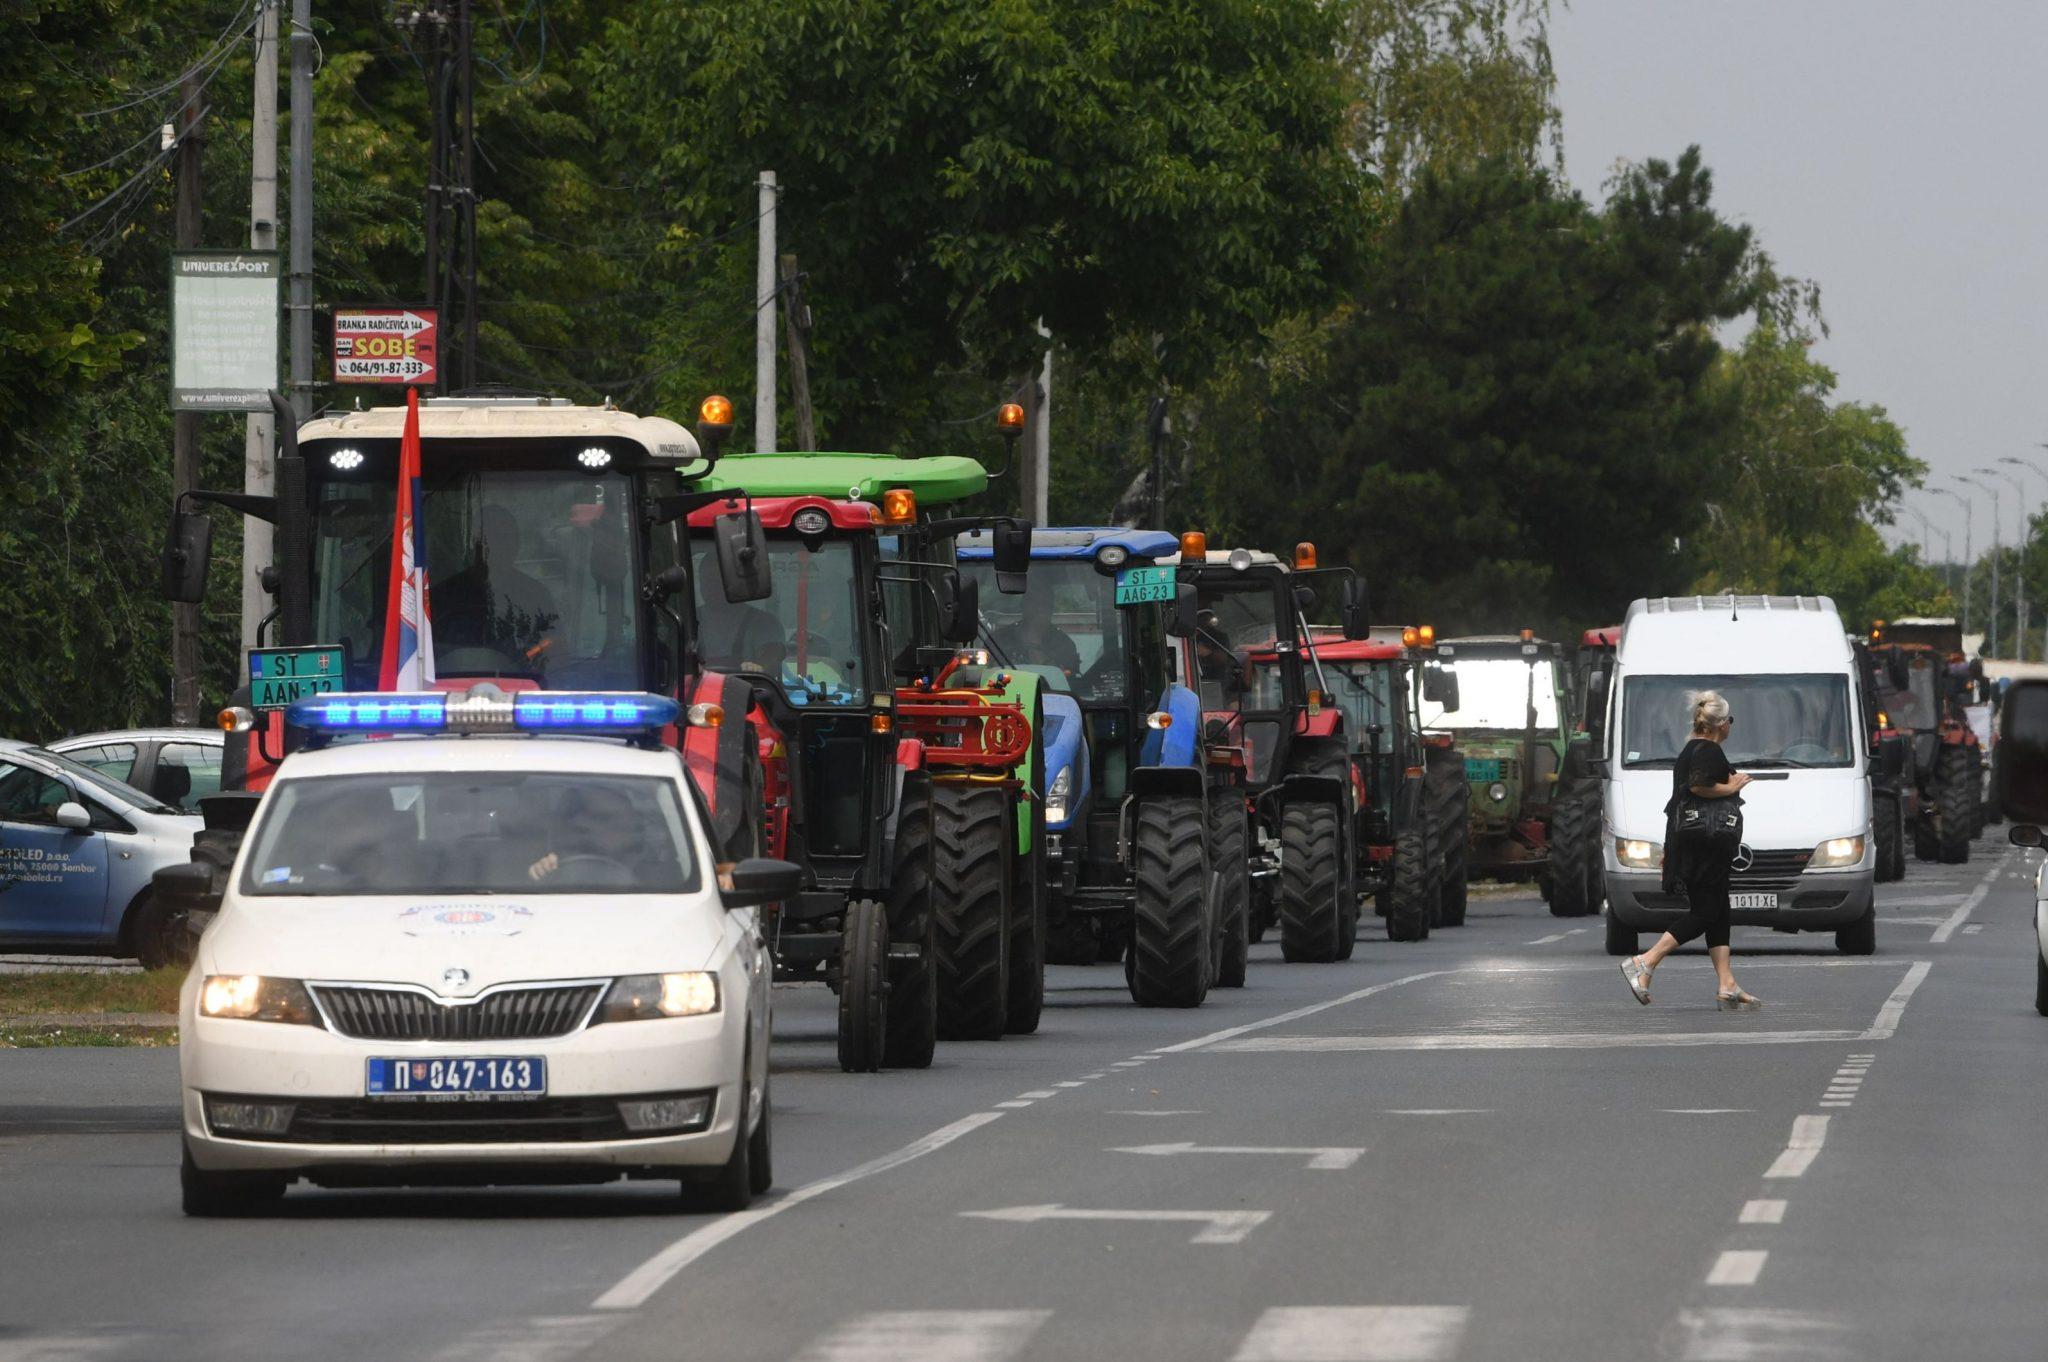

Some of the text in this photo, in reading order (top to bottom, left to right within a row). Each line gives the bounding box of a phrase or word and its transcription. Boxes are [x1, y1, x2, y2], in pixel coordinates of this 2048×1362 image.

[182, 256, 269, 273] UNIVEREXPORT
[337, 319, 367, 330] BRANKA
[411, 319, 423, 330] 144
[355, 337, 416, 356] SOBE
[349, 361, 423, 375] 064/91-87-333
[1132, 570, 1148, 585] ST
[274, 653, 299, 677] ST
